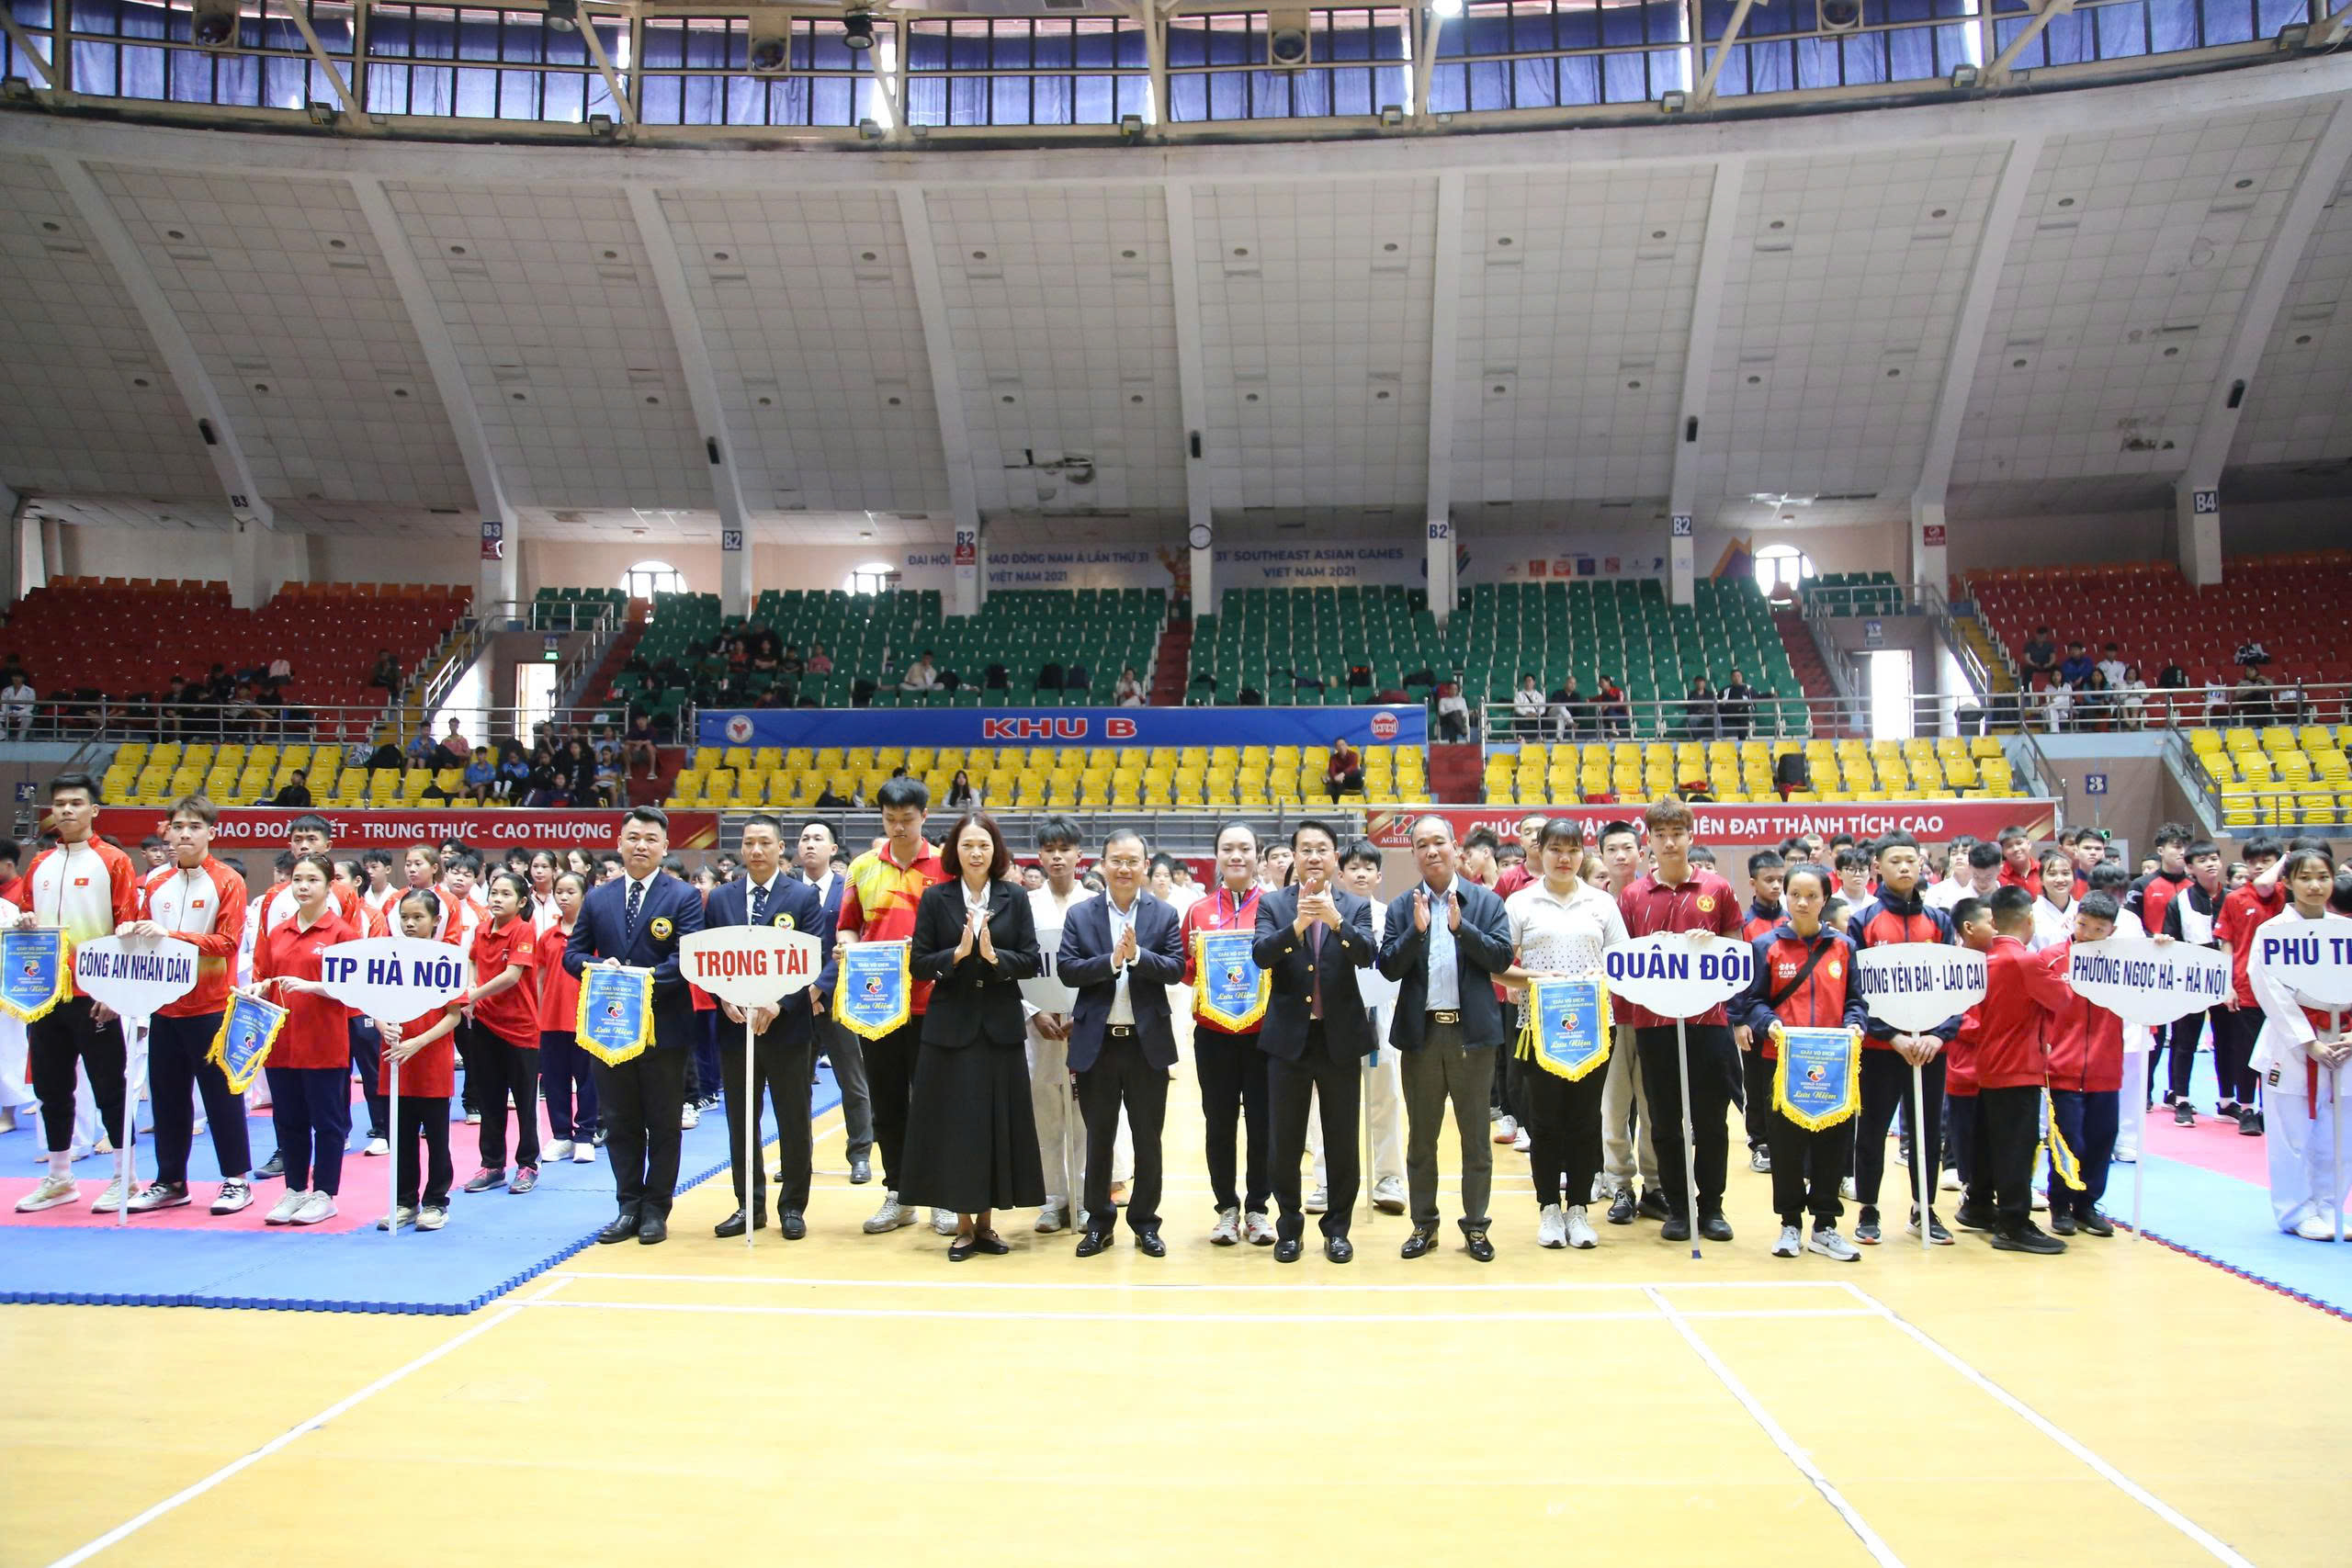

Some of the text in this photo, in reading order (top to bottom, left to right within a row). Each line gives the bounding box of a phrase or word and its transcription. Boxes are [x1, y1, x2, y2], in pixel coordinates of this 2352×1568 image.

[232, 495, 249, 508] B3
[2196, 492, 2216, 513] B4
[483, 524, 501, 537] B3
[1429, 524, 1448, 539] B2
[1673, 516, 1690, 535] B2
[725, 532, 741, 548] B2
[956, 531, 975, 545] B2
[931, 553, 951, 568] HỘI
[1047, 554, 1073, 563] NAM
[1234, 550, 1309, 561] SOUTHEAST
[1315, 550, 1354, 560] ASIAN
[1358, 548, 1404, 559] GAMES
[989, 570, 1068, 582] VIỆT NAM 2021
[1295, 567, 1326, 577] NAM
[1329, 567, 1356, 577] 2021
[983, 717, 1137, 739] KHU B
[2088, 776, 2104, 791] 3
[215, 822, 251, 838] HAO
[254, 819, 293, 838] ĐOÀ
[332, 818, 348, 839] ẾT
[362, 823, 424, 839] TRUNG
[492, 823, 530, 839] CAO
[536, 821, 612, 842] THƯỢNG
[1693, 816, 1724, 835] IÊN
[1729, 817, 1769, 839] ĐẠT
[1772, 814, 1843, 834] THÀNH
[1848, 813, 1894, 833] TÍCH
[1899, 816, 1944, 833] CAO
[2263, 931, 2319, 964] PHÚ
[79, 946, 109, 977] CÔNG
[112, 953, 129, 979] AN
[130, 950, 164, 982] NHÂN
[166, 953, 190, 983] DÂN
[324, 952, 461, 993] TP HÀ NỘI
[694, 943, 808, 982] TRỌNG TÀI
[1607, 943, 1750, 987] QUÂN ĐỘI
[1860, 961, 1889, 994] ƯỜNG
[1891, 961, 1912, 992] YÊN
[1915, 960, 1933, 992] BÁI
[1942, 959, 1962, 990] LÀO
[1966, 964, 1984, 990] CAI
[2073, 950, 2120, 985] PHƯỜNG
[2123, 960, 2155, 993] NGỌC
[2158, 959, 2174, 990] HÀ
[2186, 962, 2200, 993] HÀ
[2205, 964, 2226, 999] NỘI
